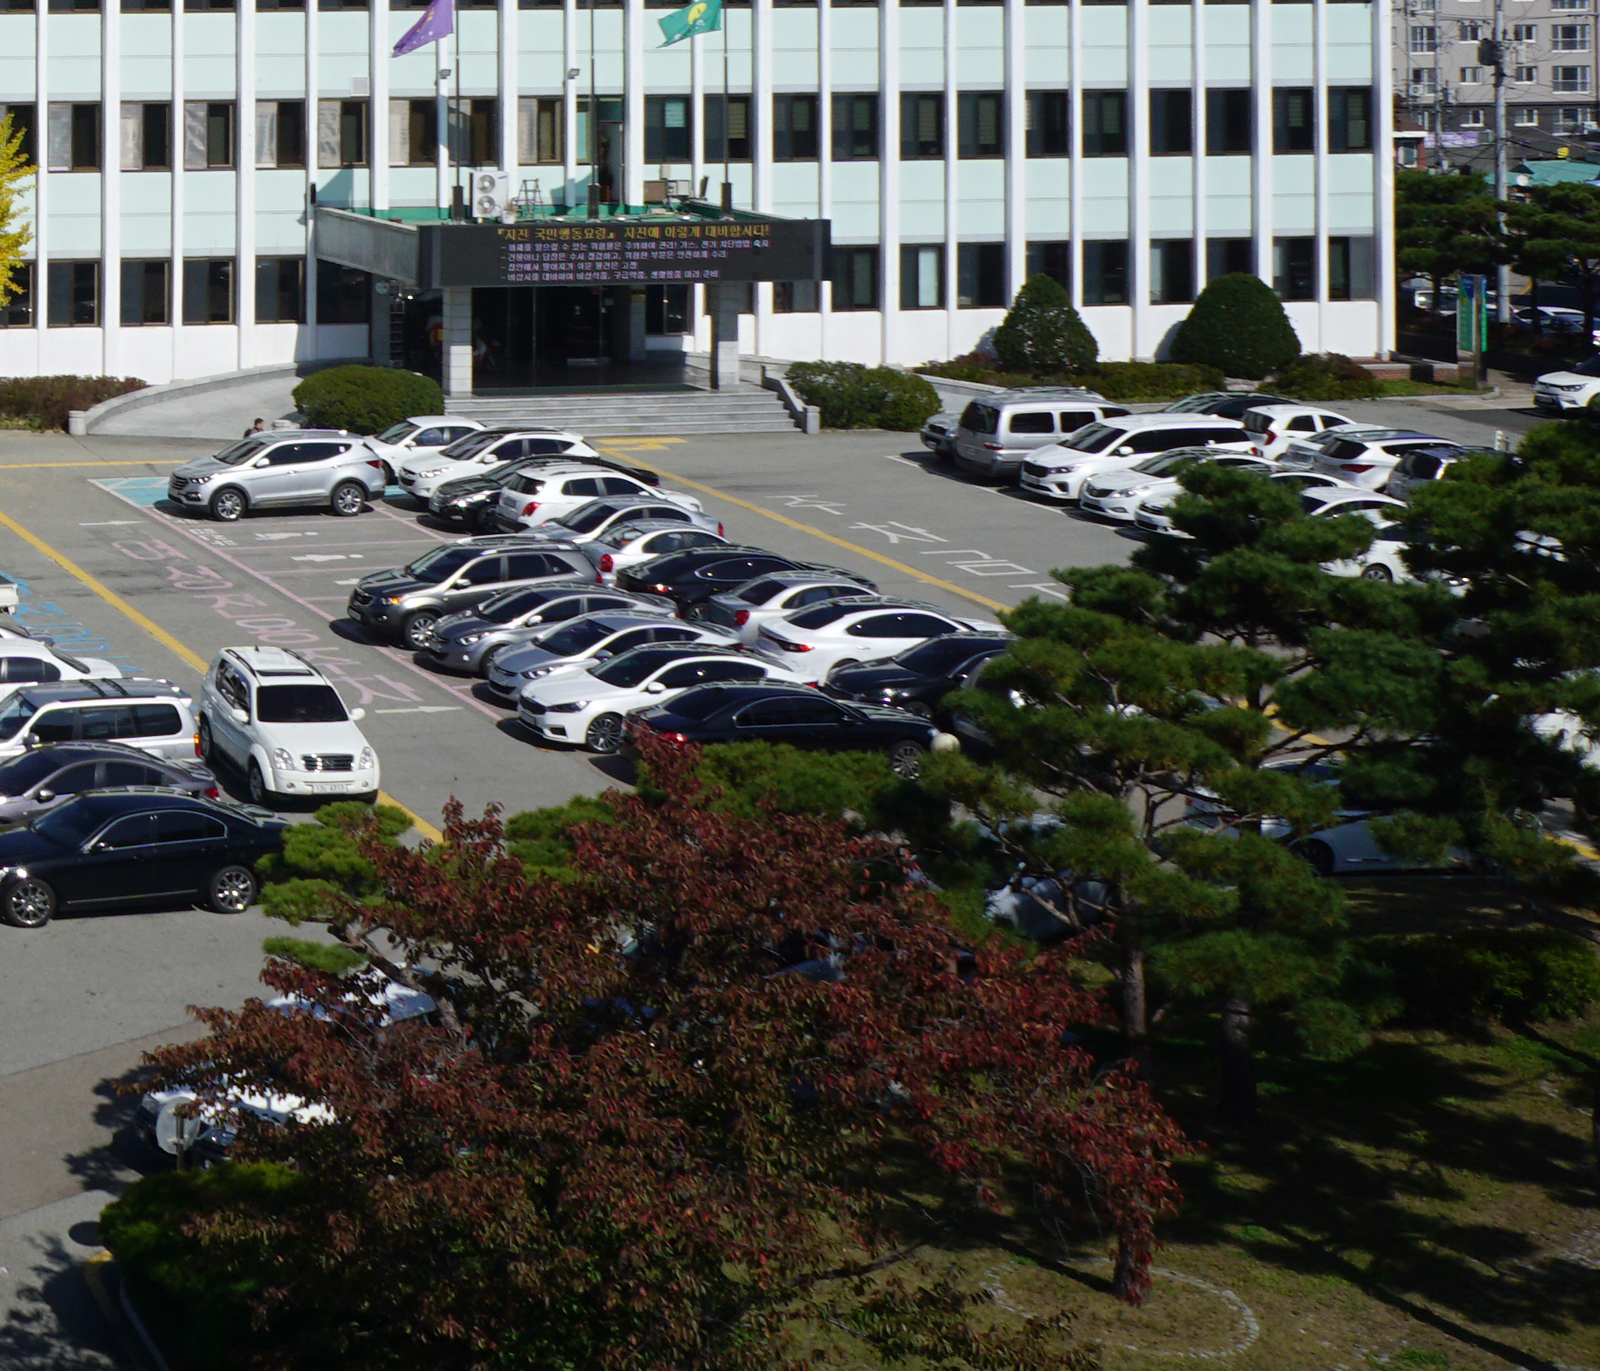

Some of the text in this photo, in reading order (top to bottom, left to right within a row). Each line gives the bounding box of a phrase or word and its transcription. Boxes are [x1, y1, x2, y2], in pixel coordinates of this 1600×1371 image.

[624, 227, 661, 238] 지진에
[665, 225, 701, 238] 이렇게
[705, 225, 770, 237] 대비합시다!
